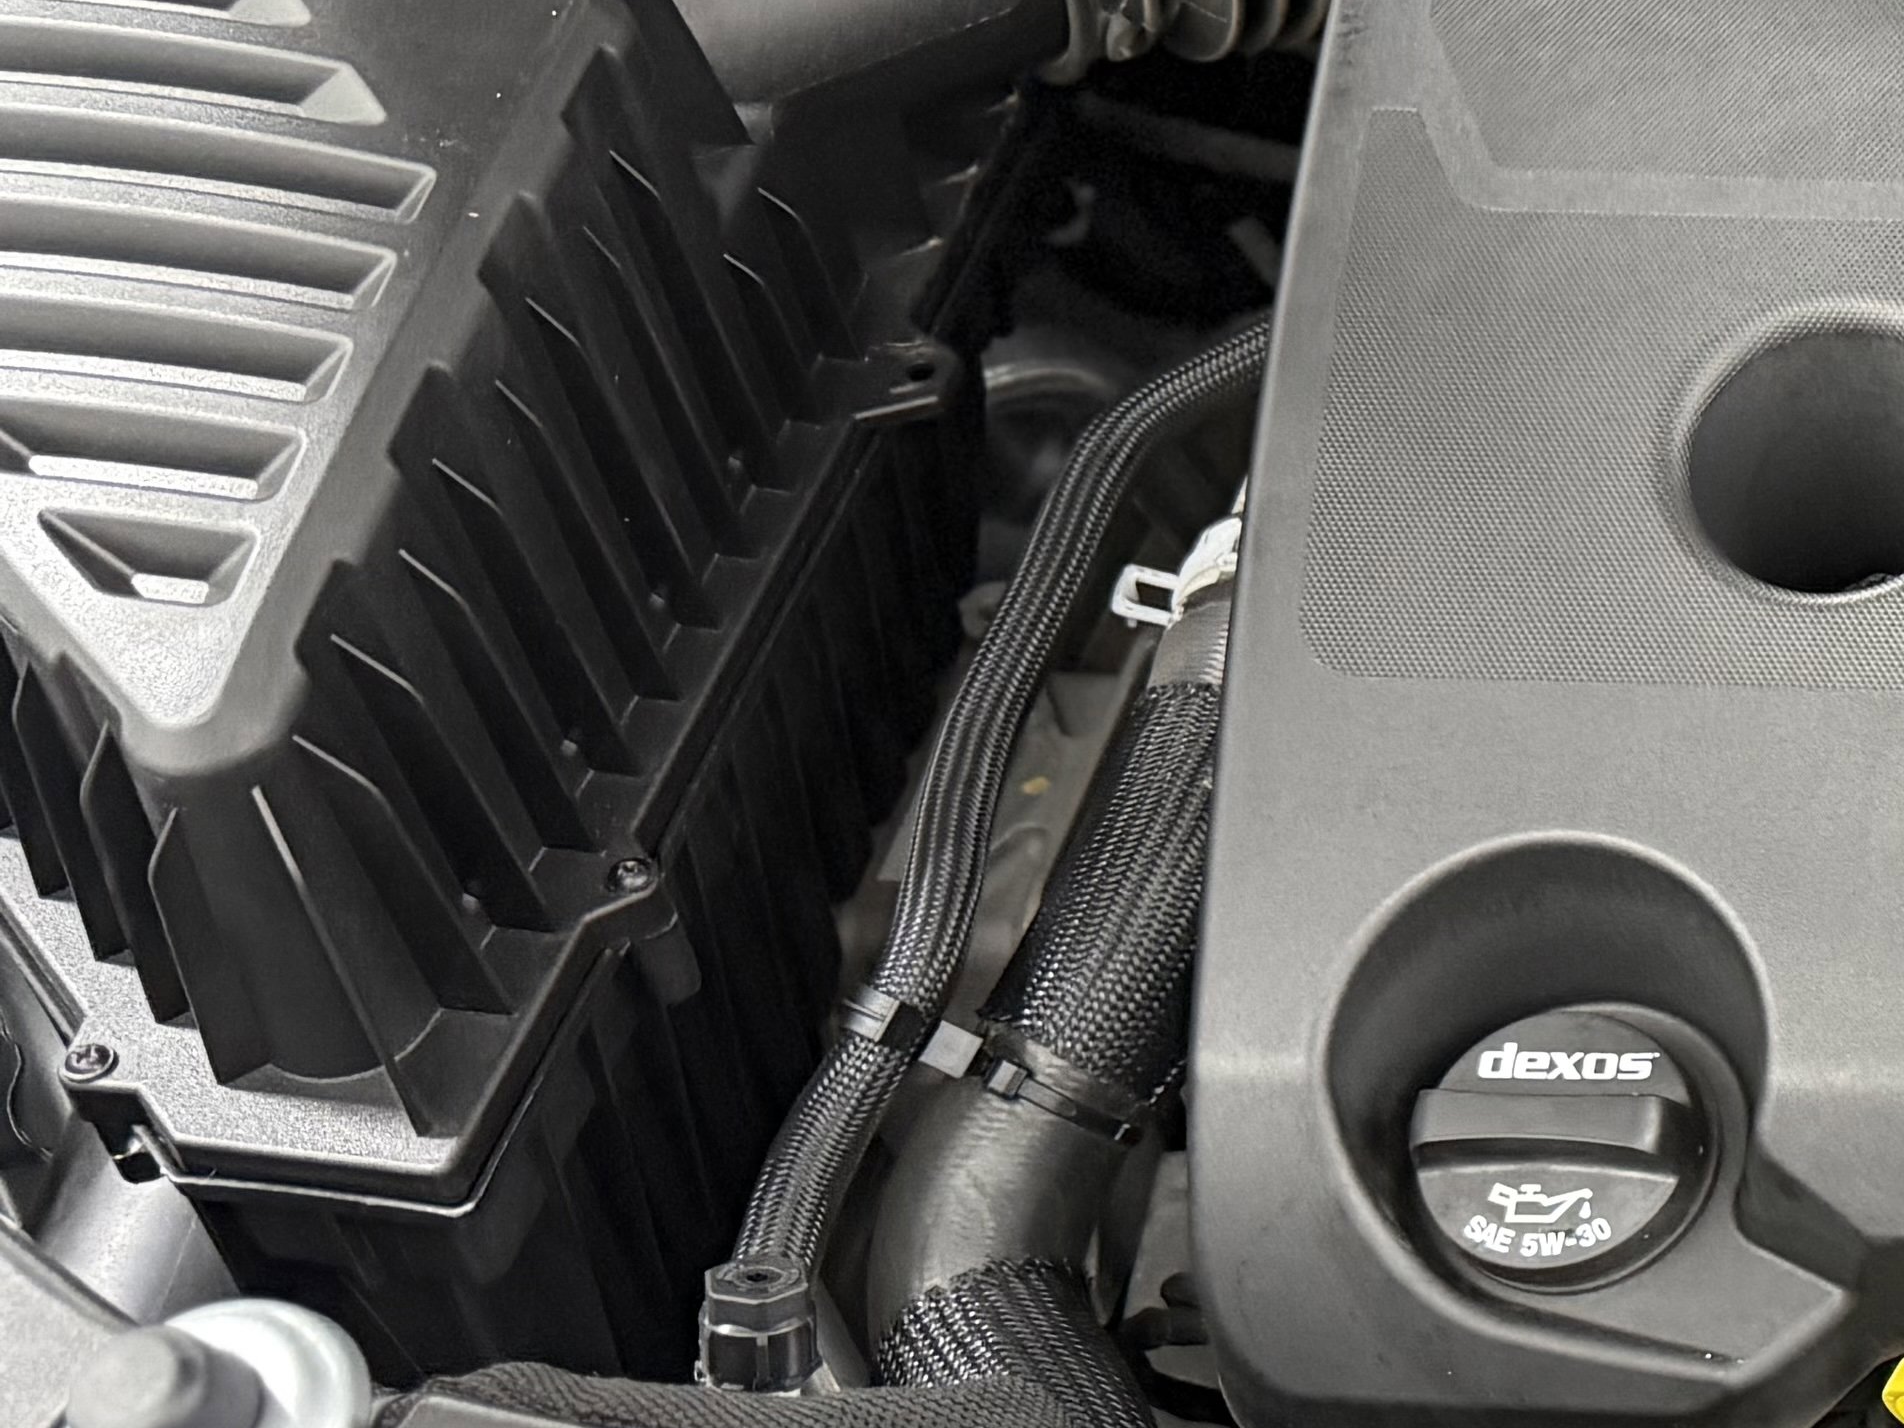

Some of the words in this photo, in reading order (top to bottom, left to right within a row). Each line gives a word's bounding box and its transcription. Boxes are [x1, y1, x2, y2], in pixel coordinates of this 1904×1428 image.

[1477, 1042, 1654, 1080] dexos
[1464, 1215, 1516, 1254] SAE
[1520, 1217, 1612, 1257] 5W-30
